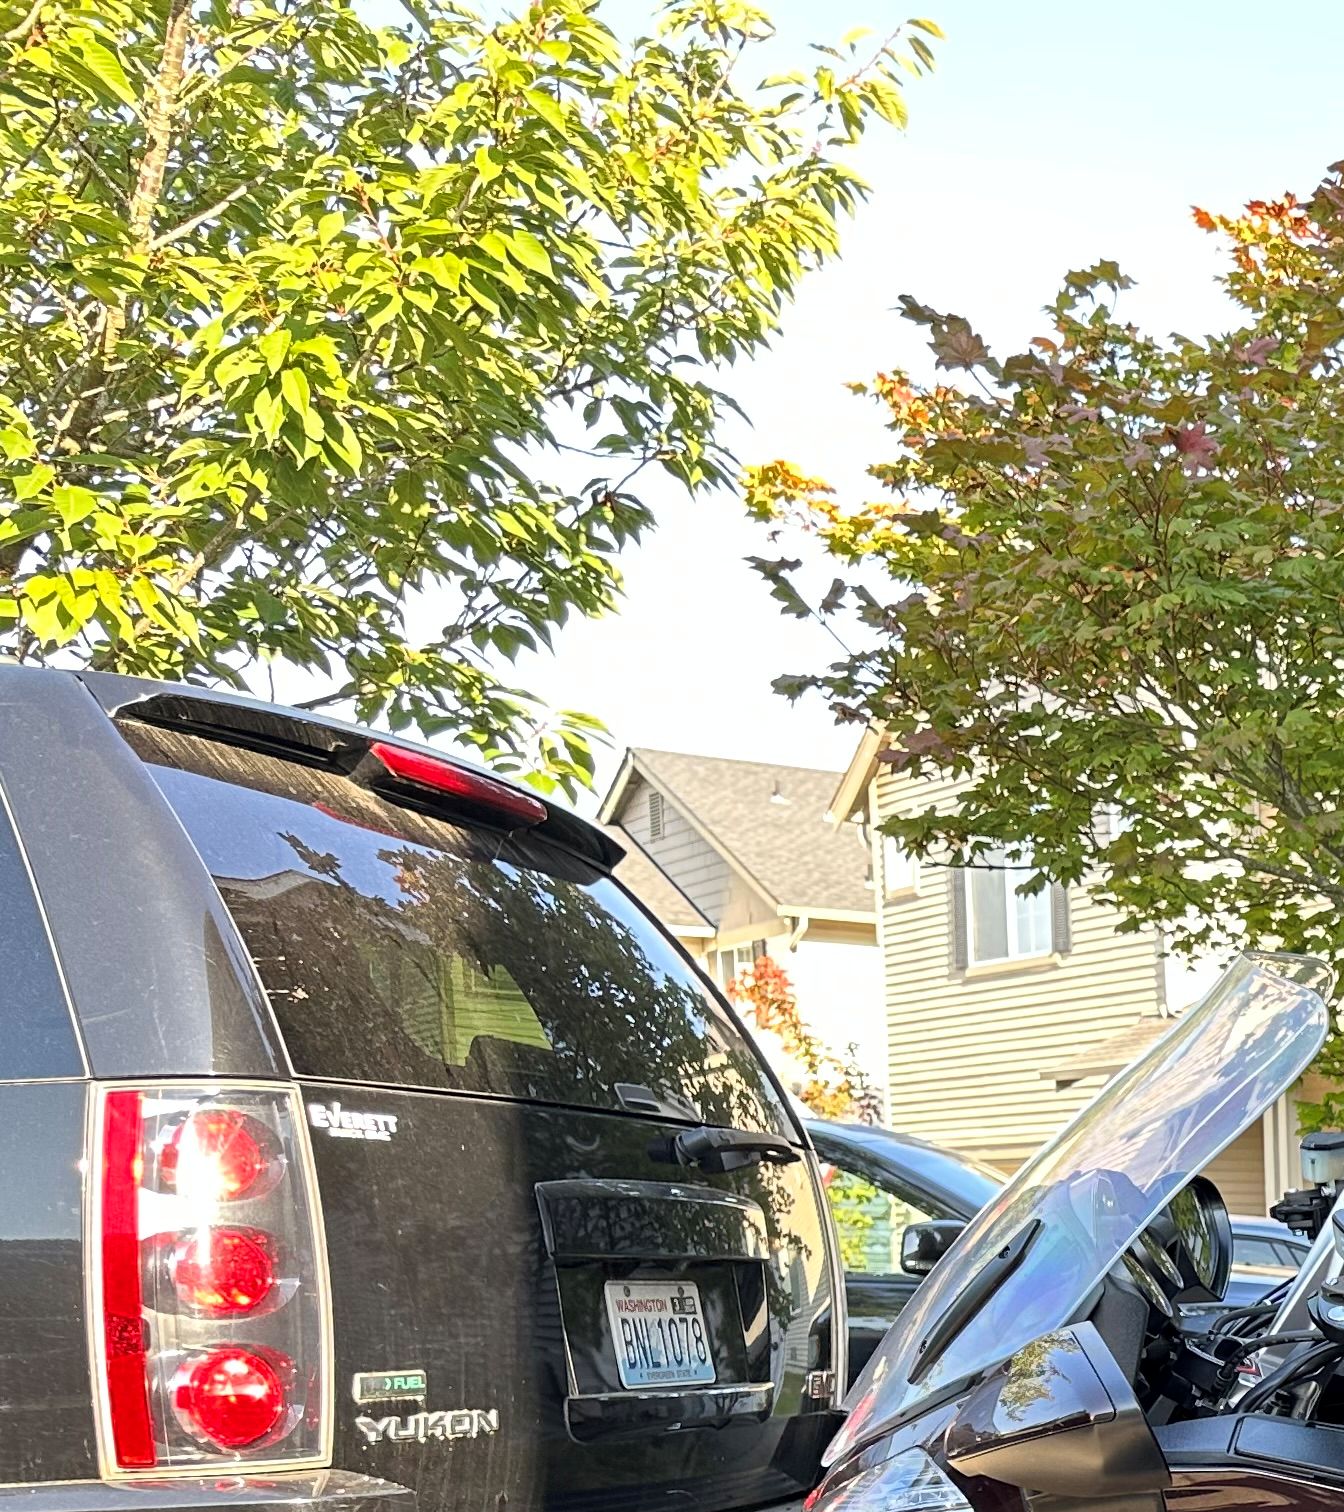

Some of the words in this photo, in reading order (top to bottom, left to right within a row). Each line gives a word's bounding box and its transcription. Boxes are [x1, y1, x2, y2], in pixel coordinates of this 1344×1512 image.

[308, 1101, 398, 1133] EVERETT
[616, 1298, 668, 1313] WASHINGTON
[620, 1317, 707, 1370] BNL1078
[394, 1376, 426, 1389] FUEL
[355, 1408, 500, 1444] YUKON
